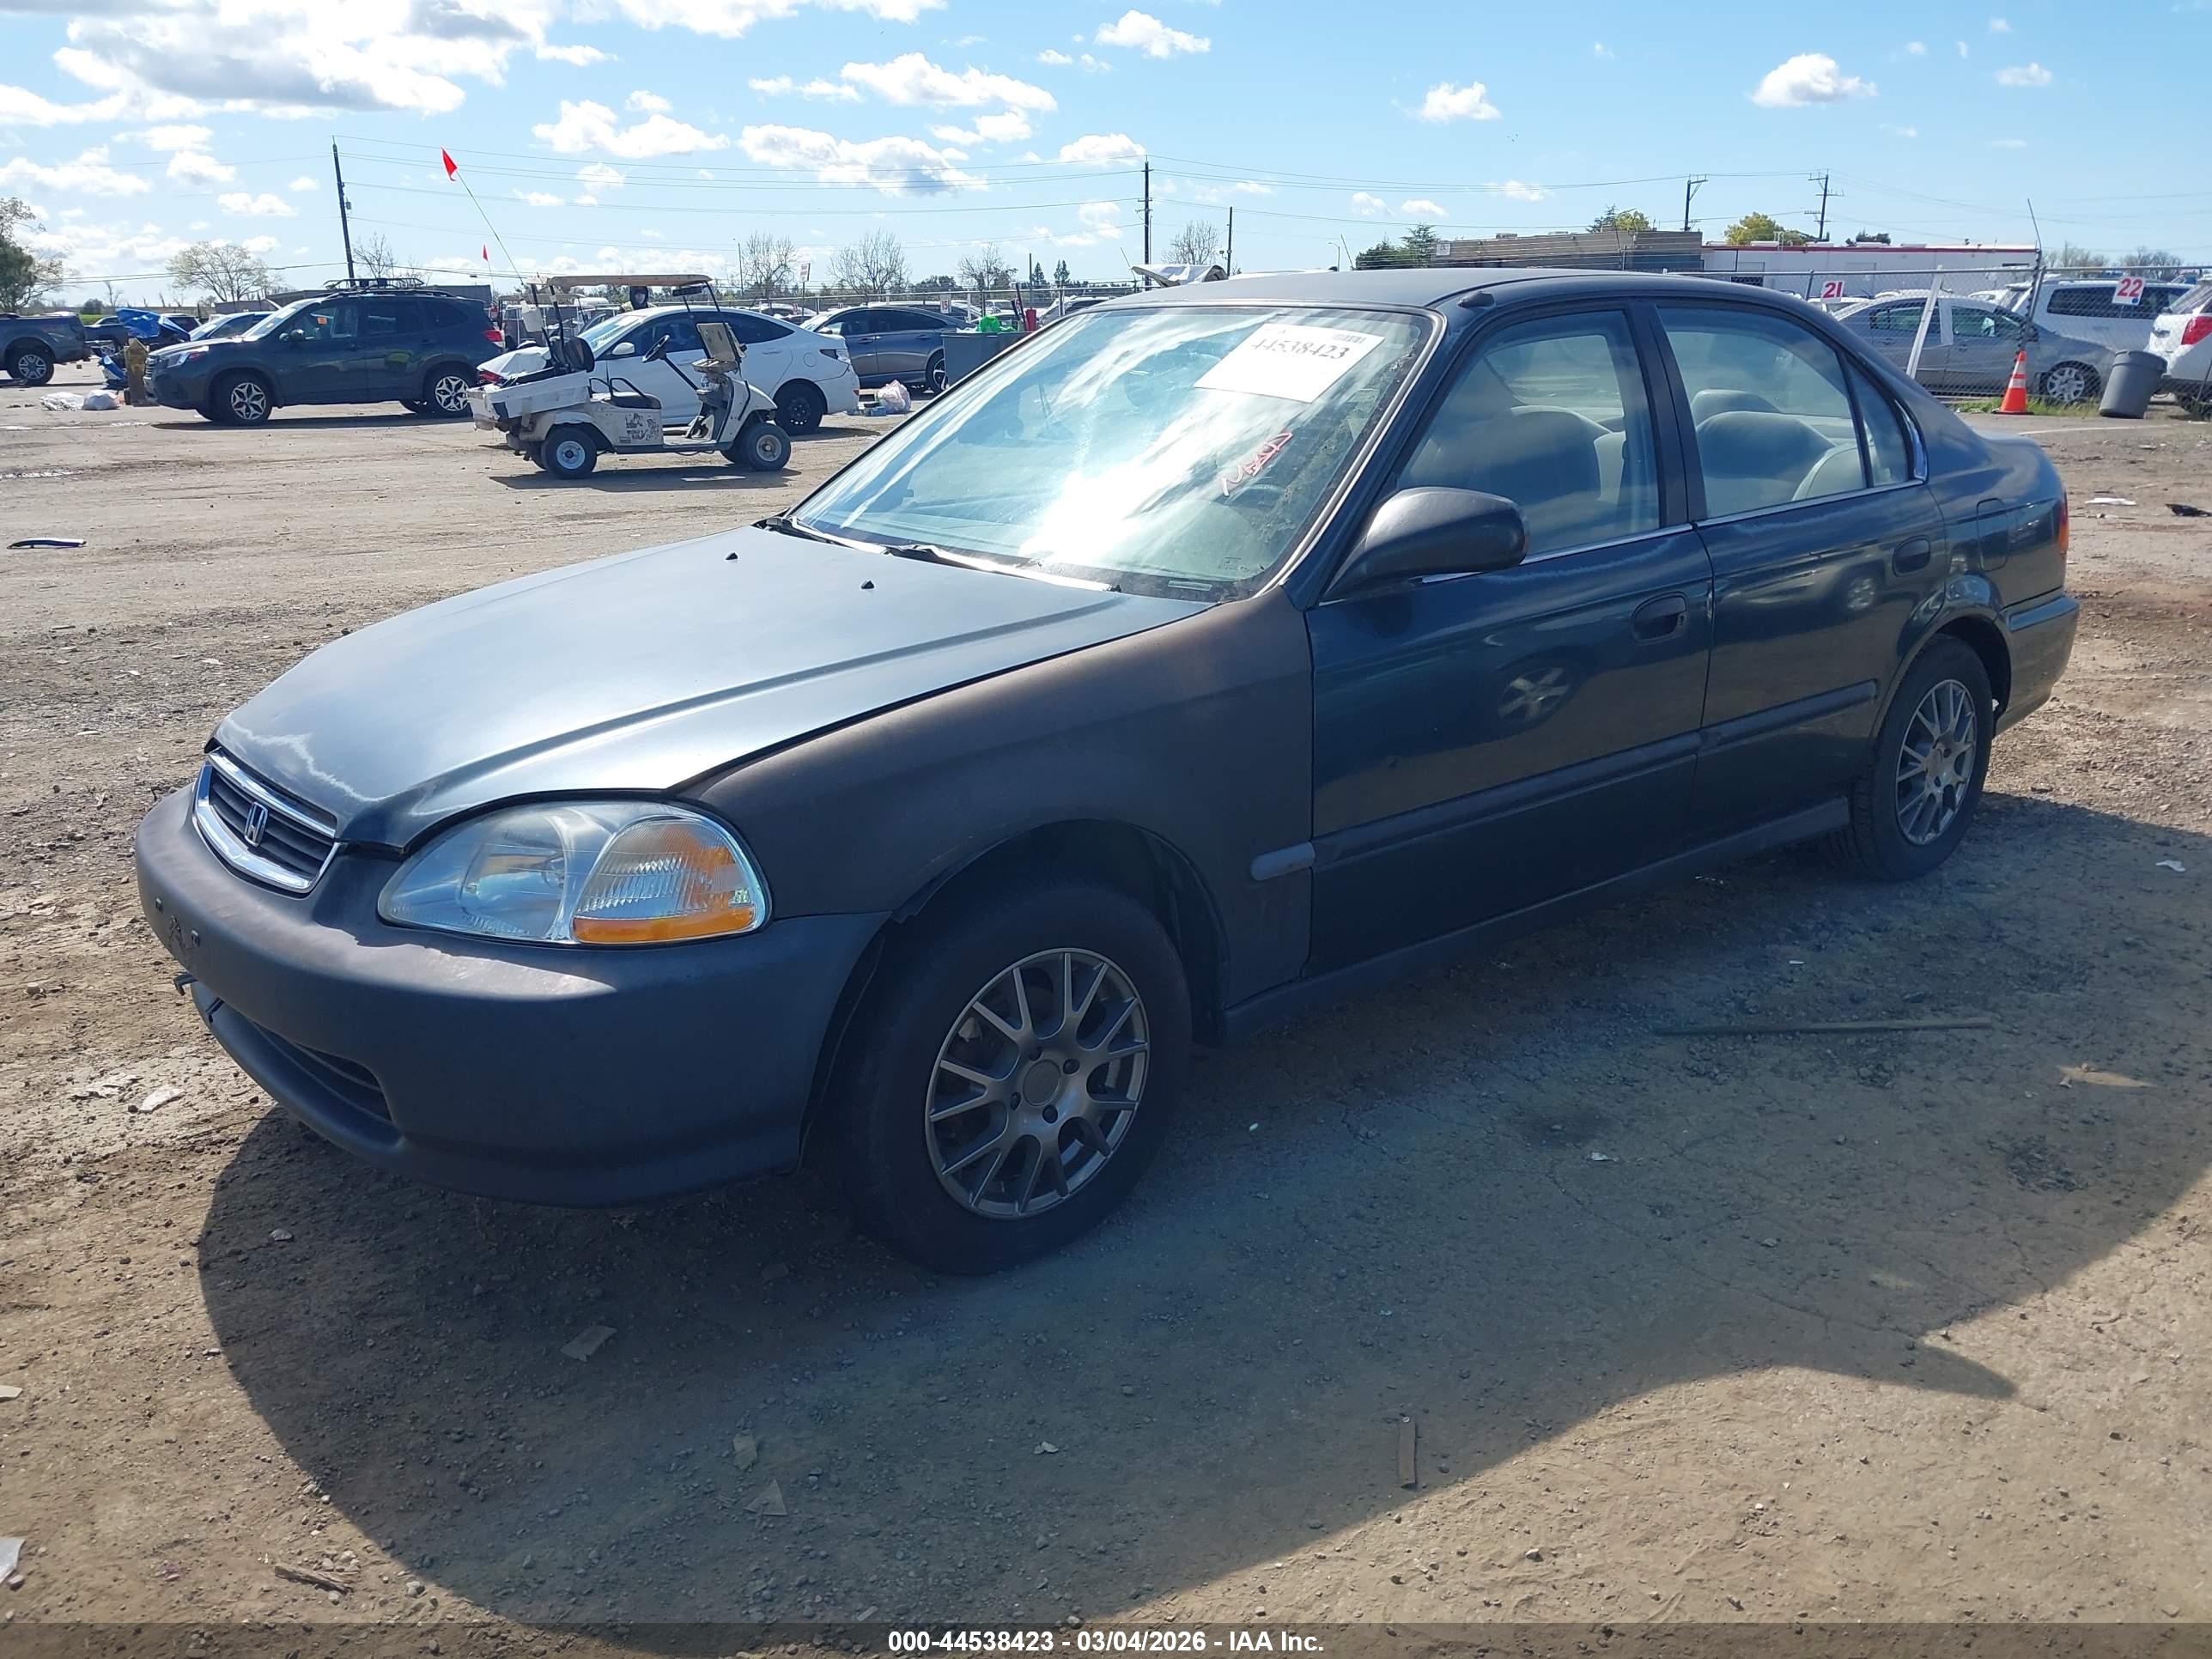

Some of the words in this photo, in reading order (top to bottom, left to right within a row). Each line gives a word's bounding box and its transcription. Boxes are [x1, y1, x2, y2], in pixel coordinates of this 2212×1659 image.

[1822, 281, 1844, 298] 21
[2117, 277, 2143, 297] 22
[1251, 338, 1350, 359] 44538423
